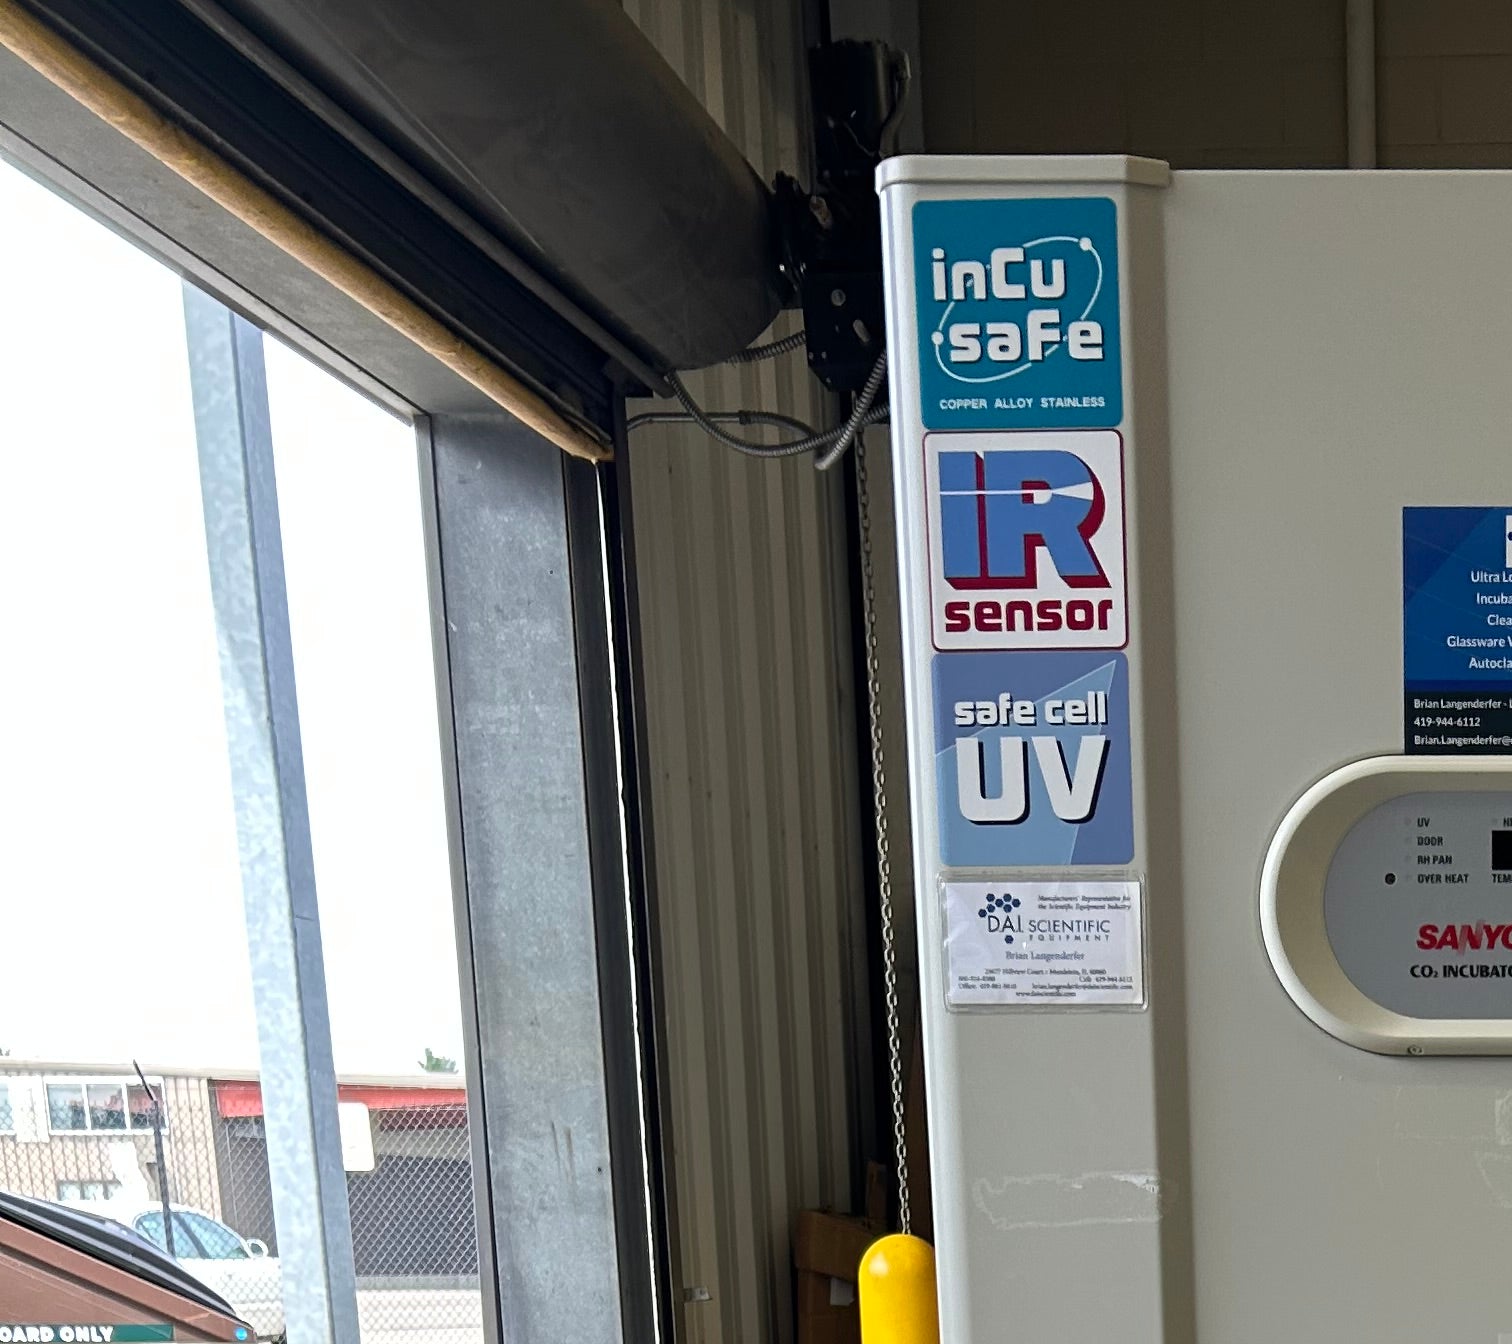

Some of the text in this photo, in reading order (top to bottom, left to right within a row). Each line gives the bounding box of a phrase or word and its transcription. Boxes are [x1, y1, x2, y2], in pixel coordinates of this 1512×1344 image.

[932, 247, 1067, 300] inCu
[940, 396, 1105, 410] COPPER ALLOY STAINLESS
[938, 450, 1112, 589] IR
[1471, 571, 1500, 583] Ultra
[944, 600, 1113, 632] sensor
[1447, 636, 1506, 648] Glassware
[955, 691, 1108, 727] safe cell
[1414, 699, 1439, 709] Brian
[1441, 699, 1502, 711] Langenderfer
[1414, 717, 1481, 727] 419-944-6112
[956, 735, 1111, 825] UV
[1417, 818, 1430, 828] UV
[1417, 836, 1443, 846] DOOR
[1432, 855, 1452, 865] PAN
[1417, 874, 1469, 884] OVER HEAT
[1029, 919, 1110, 933] SCIENTIFIC
[1005, 951, 1028, 960] Brian
[59, 1325, 113, 1342] ONLY
